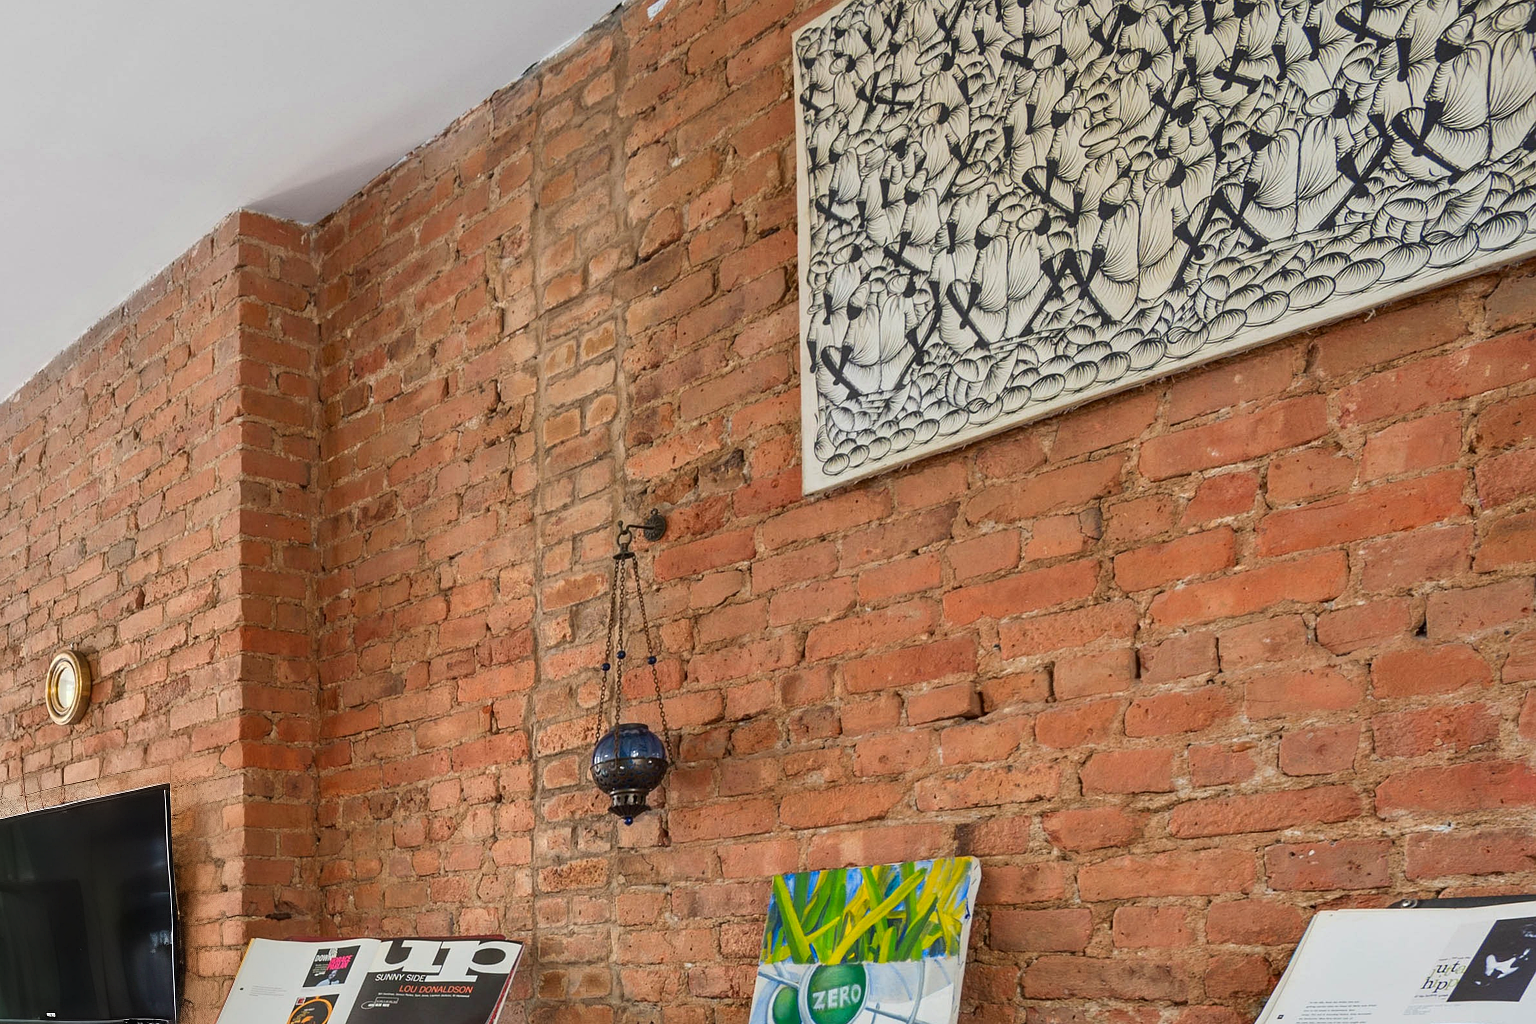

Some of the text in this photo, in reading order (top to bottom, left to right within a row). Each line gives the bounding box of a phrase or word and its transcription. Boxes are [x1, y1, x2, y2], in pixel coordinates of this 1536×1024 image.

[375, 973, 426, 982] SUNNY SIDE
[398, 984, 474, 994] LOU DONALDSON
[811, 983, 862, 1011] ZERO
